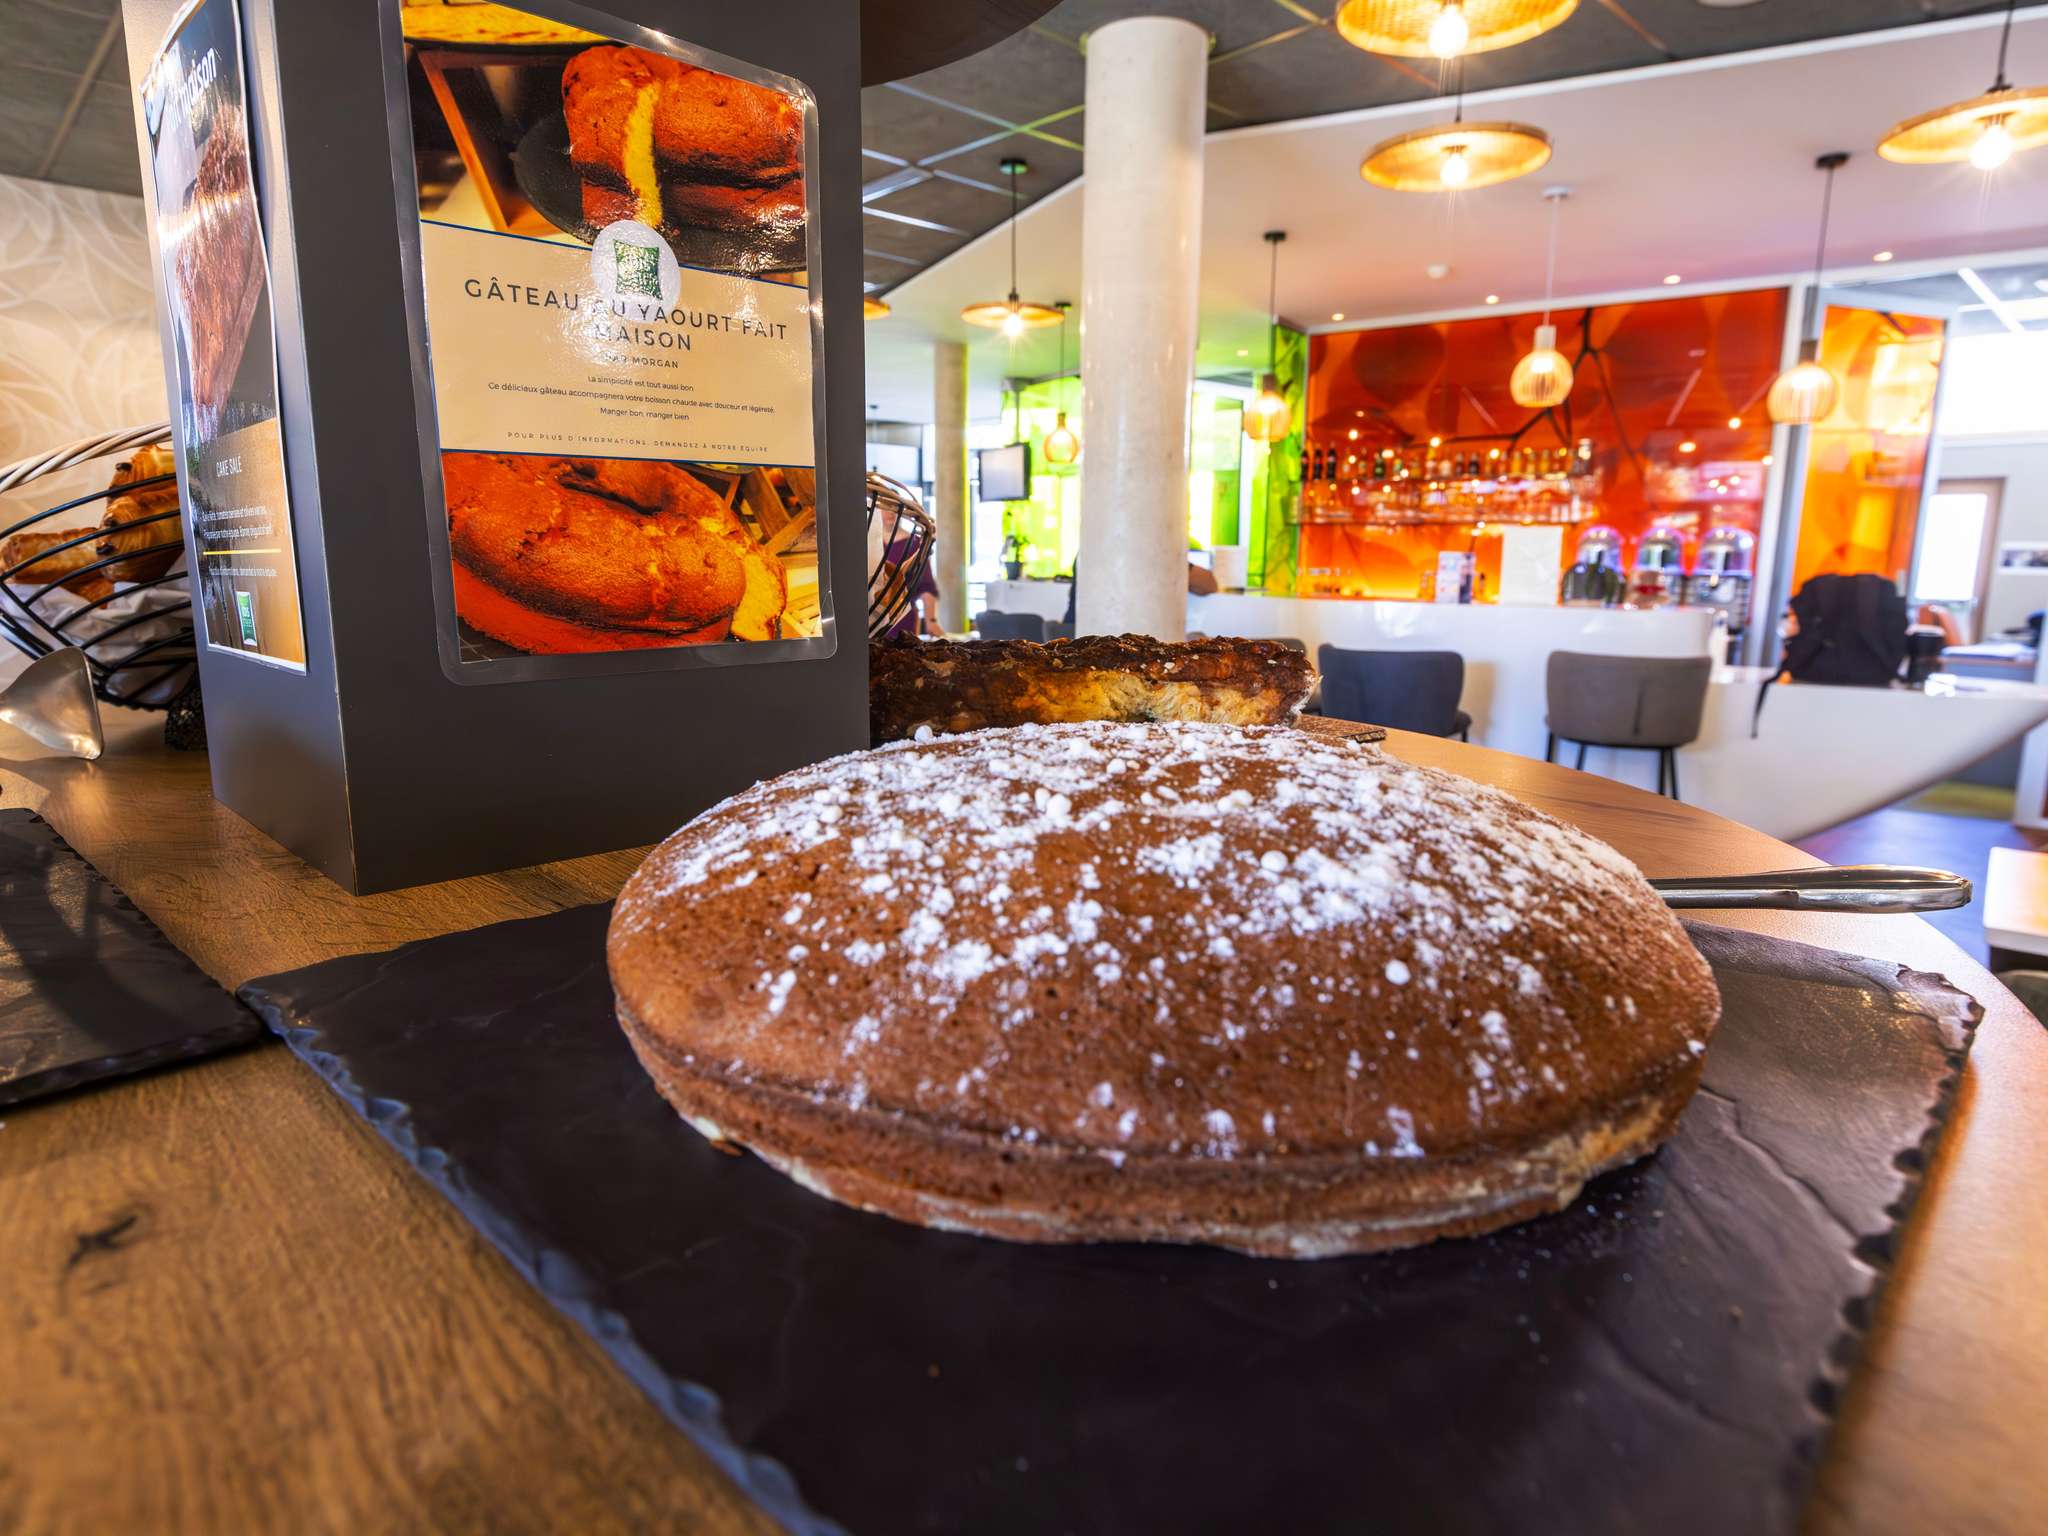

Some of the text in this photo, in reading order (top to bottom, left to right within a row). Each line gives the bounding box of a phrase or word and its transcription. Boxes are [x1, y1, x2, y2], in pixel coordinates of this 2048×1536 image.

[464, 276, 579, 311] GÂTEAU
[638, 303, 732, 332] YAOURT
[742, 319, 787, 340] FAIT
[632, 356, 679, 369] MORGAN
[634, 380, 646, 388] est
[646, 381, 661, 389] tout
[662, 382, 679, 391] aussi
[488, 382, 500, 391] Ce
[501, 383, 538, 393] délicieux
[539, 386, 567, 396] gâteau
[568, 389, 624, 401] accompagnera
[625, 394, 644, 402] votre
[645, 396, 671, 405] boisson
[672, 398, 698, 407] chaude
[698, 401, 713, 409] avec
[714, 402, 741, 411] douceur
[600, 407, 628, 417] Manger
[646, 411, 673, 420] manger
[674, 412, 690, 421] bien
[507, 431, 535, 439] POUR
[539, 433, 563, 441] PLUS
